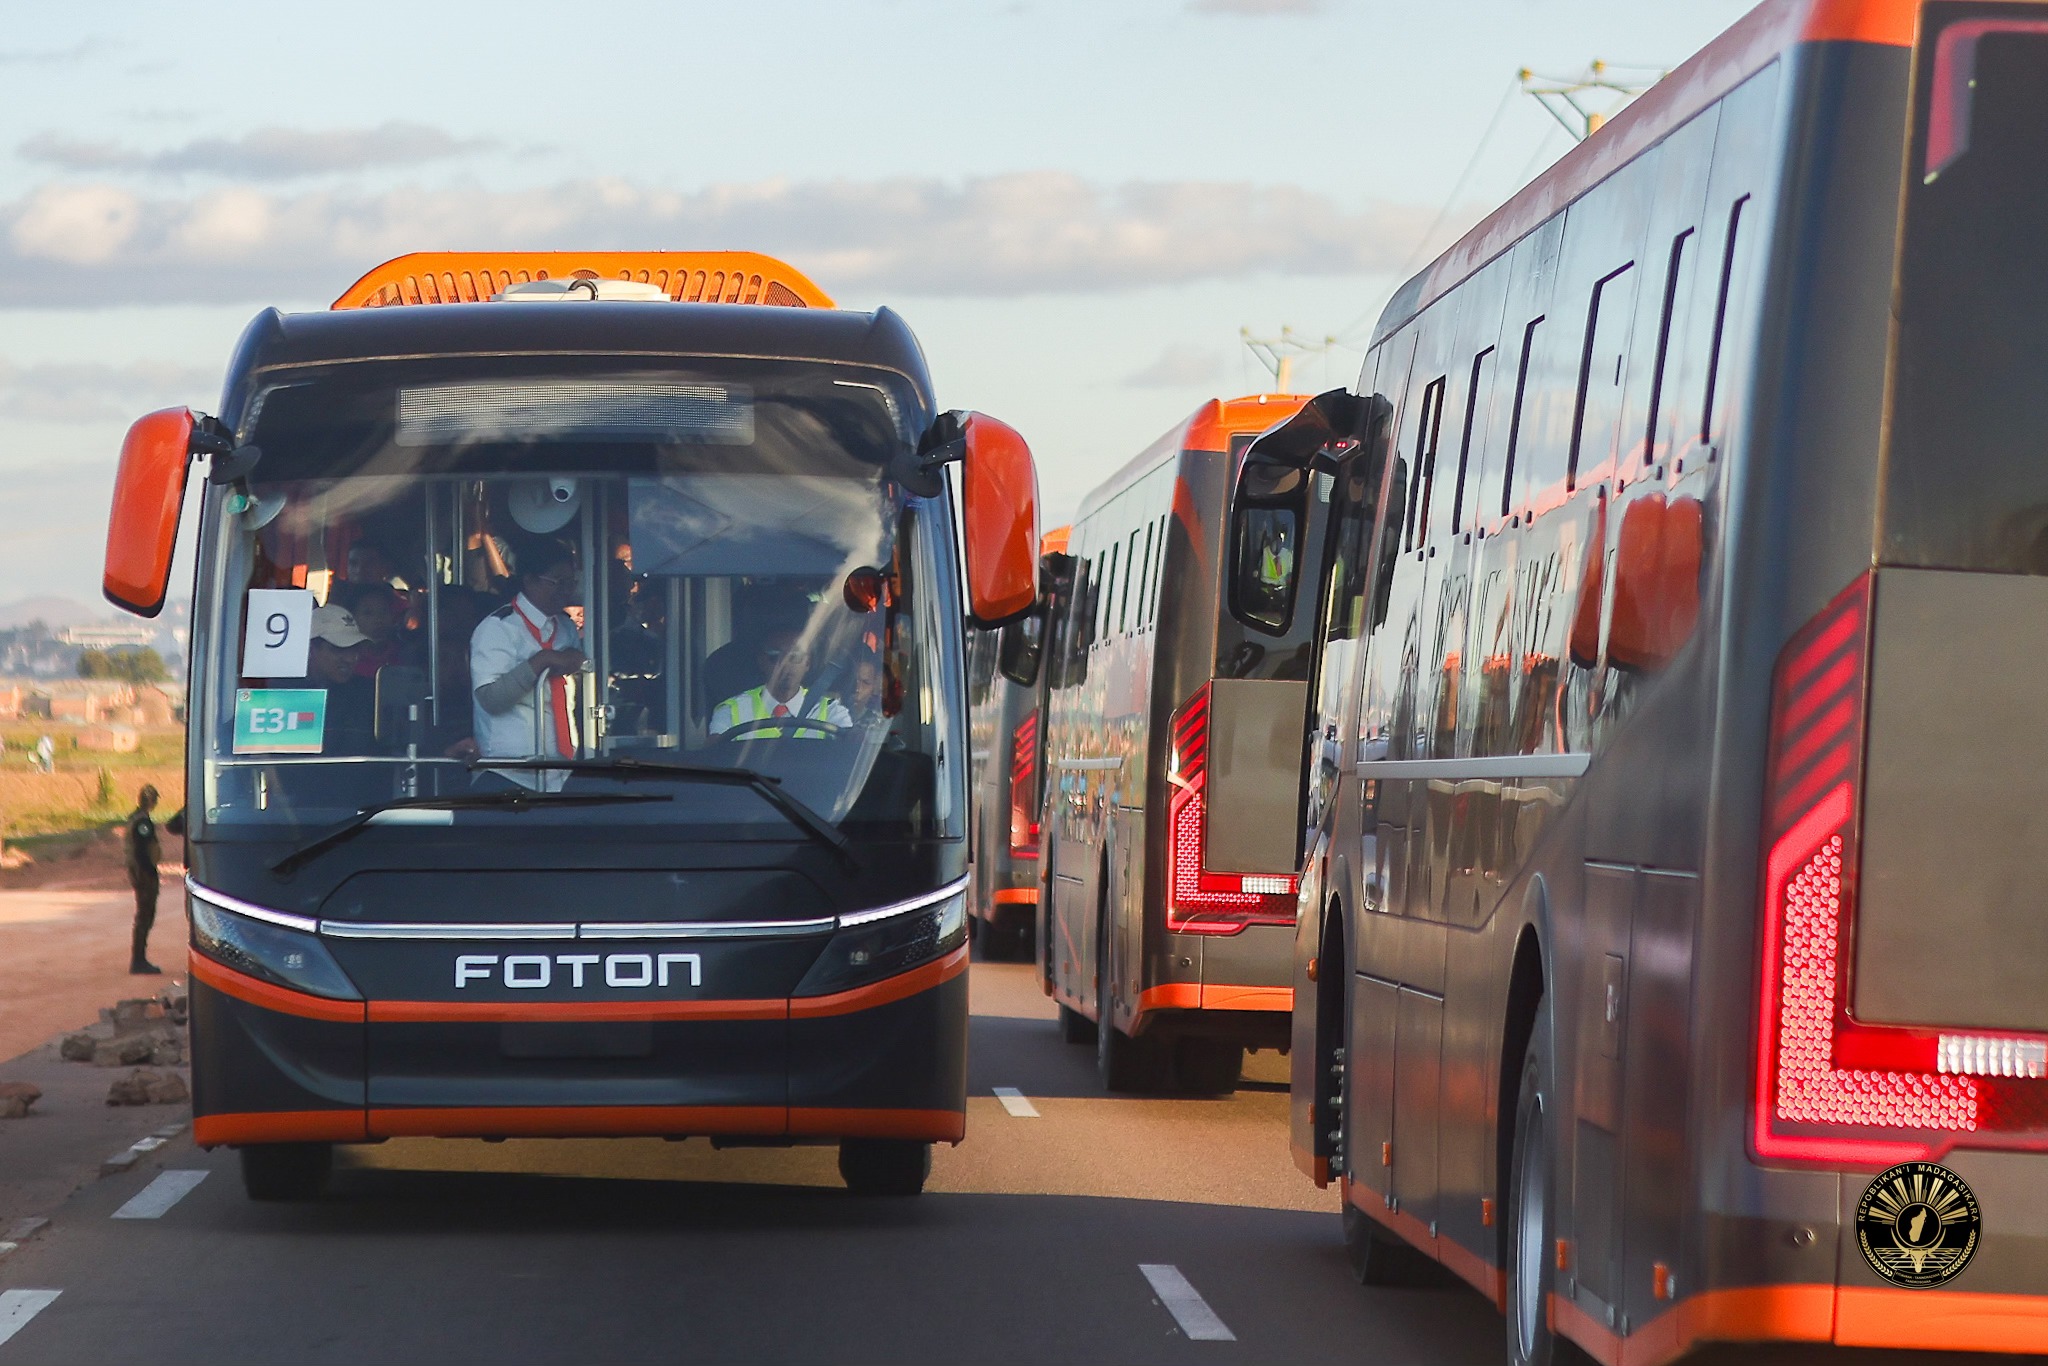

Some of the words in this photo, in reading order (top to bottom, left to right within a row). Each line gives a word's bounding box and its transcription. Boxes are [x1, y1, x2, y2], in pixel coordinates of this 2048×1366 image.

[265, 613, 289, 648] 9
[249, 708, 285, 733] E3
[455, 953, 701, 988] FOTON
